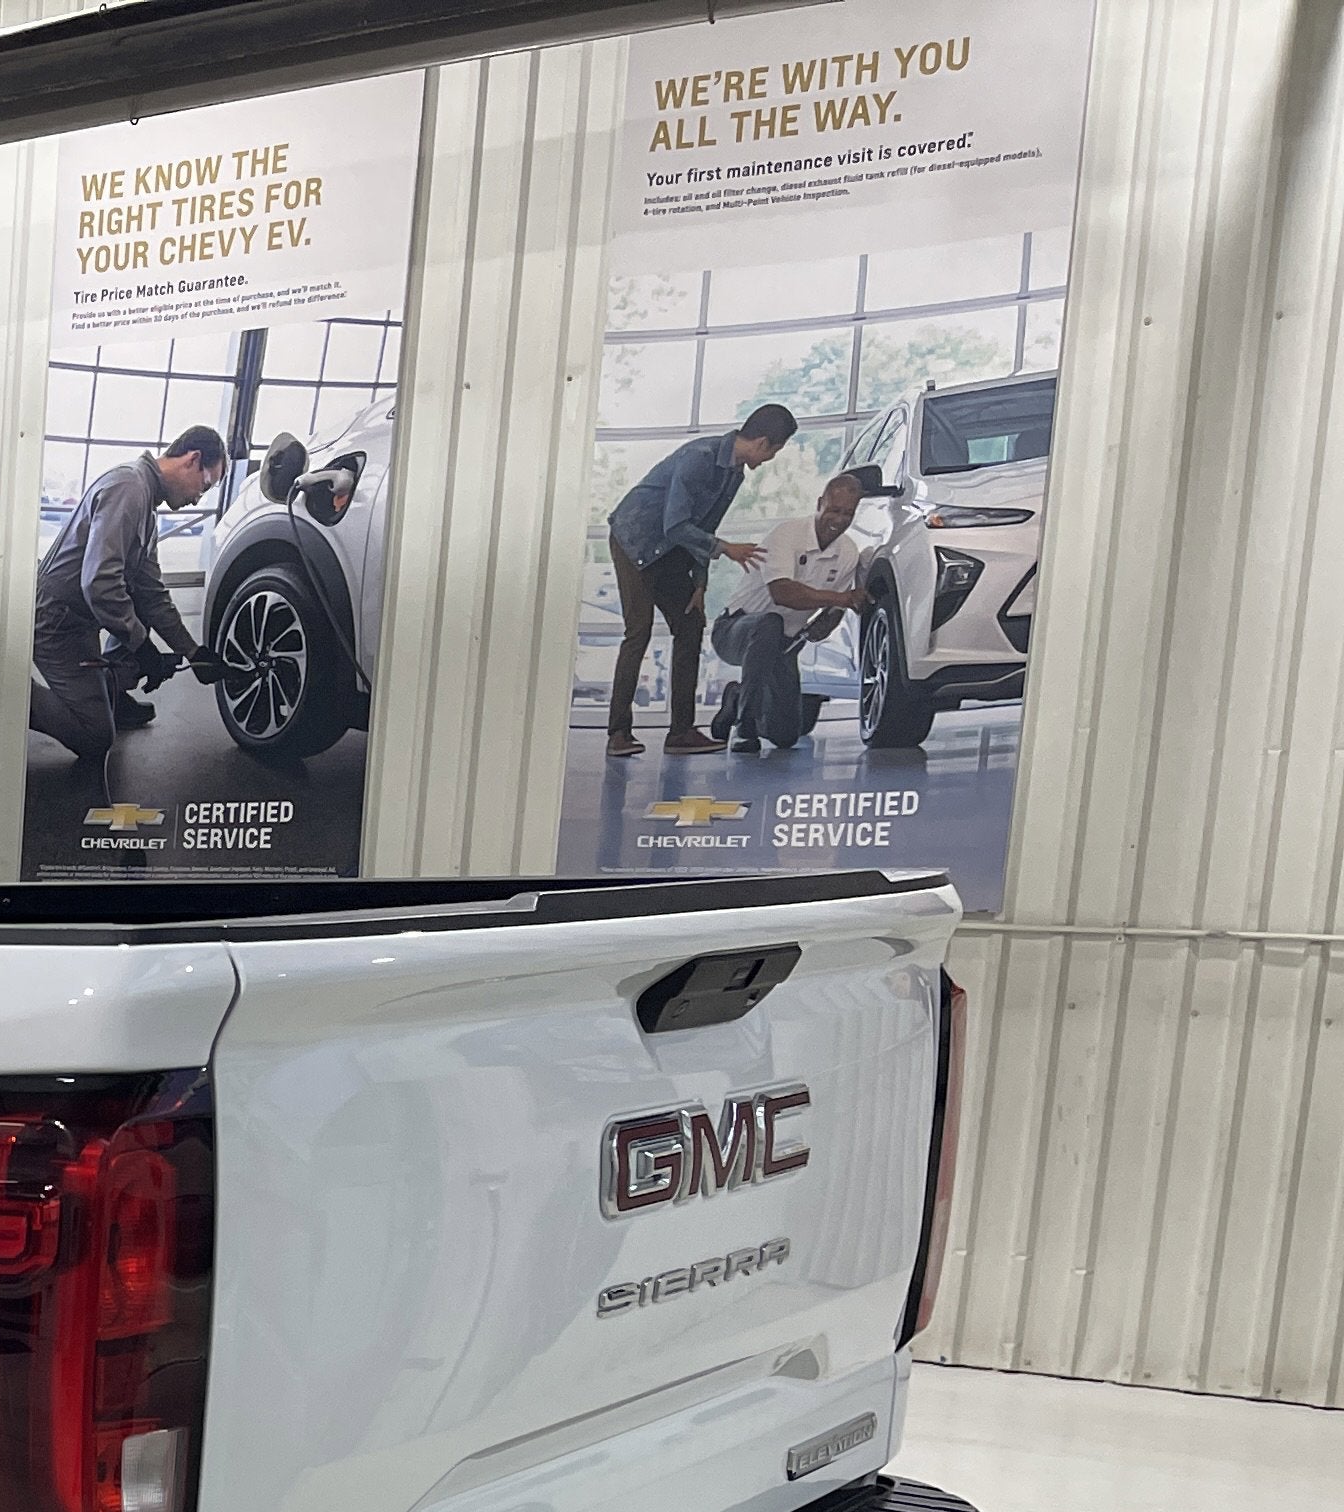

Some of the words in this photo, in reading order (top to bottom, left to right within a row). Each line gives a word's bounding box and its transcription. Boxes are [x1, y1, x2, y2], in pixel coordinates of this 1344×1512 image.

[654, 66, 770, 112] WE'RE
[782, 51, 881, 94] WITH
[894, 37, 972, 80] YOU
[649, 116, 718, 153] ALL
[730, 103, 802, 144] THE
[812, 91, 904, 134] WAY.
[81, 170, 126, 202] WE
[134, 154, 224, 196] KNOW
[230, 143, 290, 178] THE
[647, 171, 683, 187] Your
[686, 166, 722, 184] first
[726, 156, 833, 179] maintenance
[837, 147, 874, 166] visit
[878, 143, 892, 160] is
[78, 201, 162, 240] RIGHT
[172, 188, 254, 228] TIRES
[264, 177, 322, 215] FOR
[722, 197, 769, 208] Multi-Point
[76, 241, 149, 276] YOUR
[158, 225, 258, 266] CHEVY
[266, 217, 312, 252] EV.
[74, 290, 98, 304] Tire
[100, 287, 132, 302] Price
[136, 280, 174, 298] Match
[178, 274, 248, 293] Guarantee.
[184, 801, 294, 824] CERTIFIED
[775, 791, 920, 818] CERTIFIED
[81, 837, 167, 850] CHEVROLET
[182, 827, 272, 850] SERVICE
[637, 835, 751, 848] CHEVROLET
[772, 822, 890, 847] SERVICE
[600, 1079, 811, 1222] GMC
[596, 1236, 791, 1319] SIERRA
[799, 1424, 873, 1469] ELEVATION
